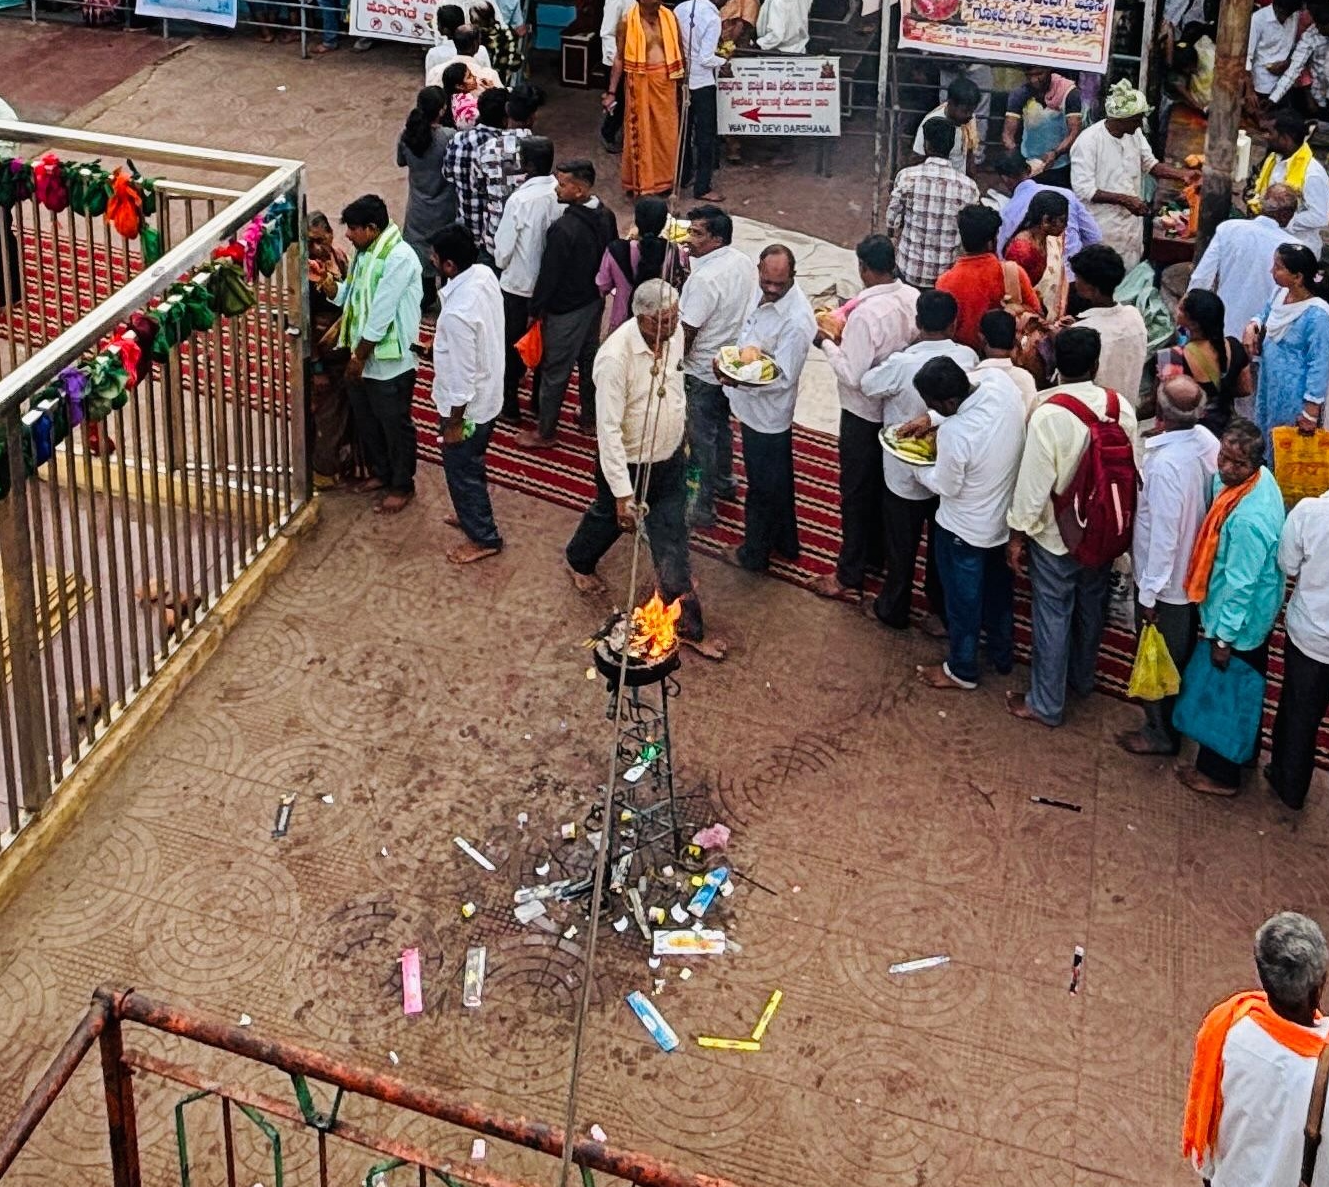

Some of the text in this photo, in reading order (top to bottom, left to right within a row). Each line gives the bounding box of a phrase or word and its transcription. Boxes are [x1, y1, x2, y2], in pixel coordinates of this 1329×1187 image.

[728, 123, 831, 133] WAY TO DEVI DARSHANA
